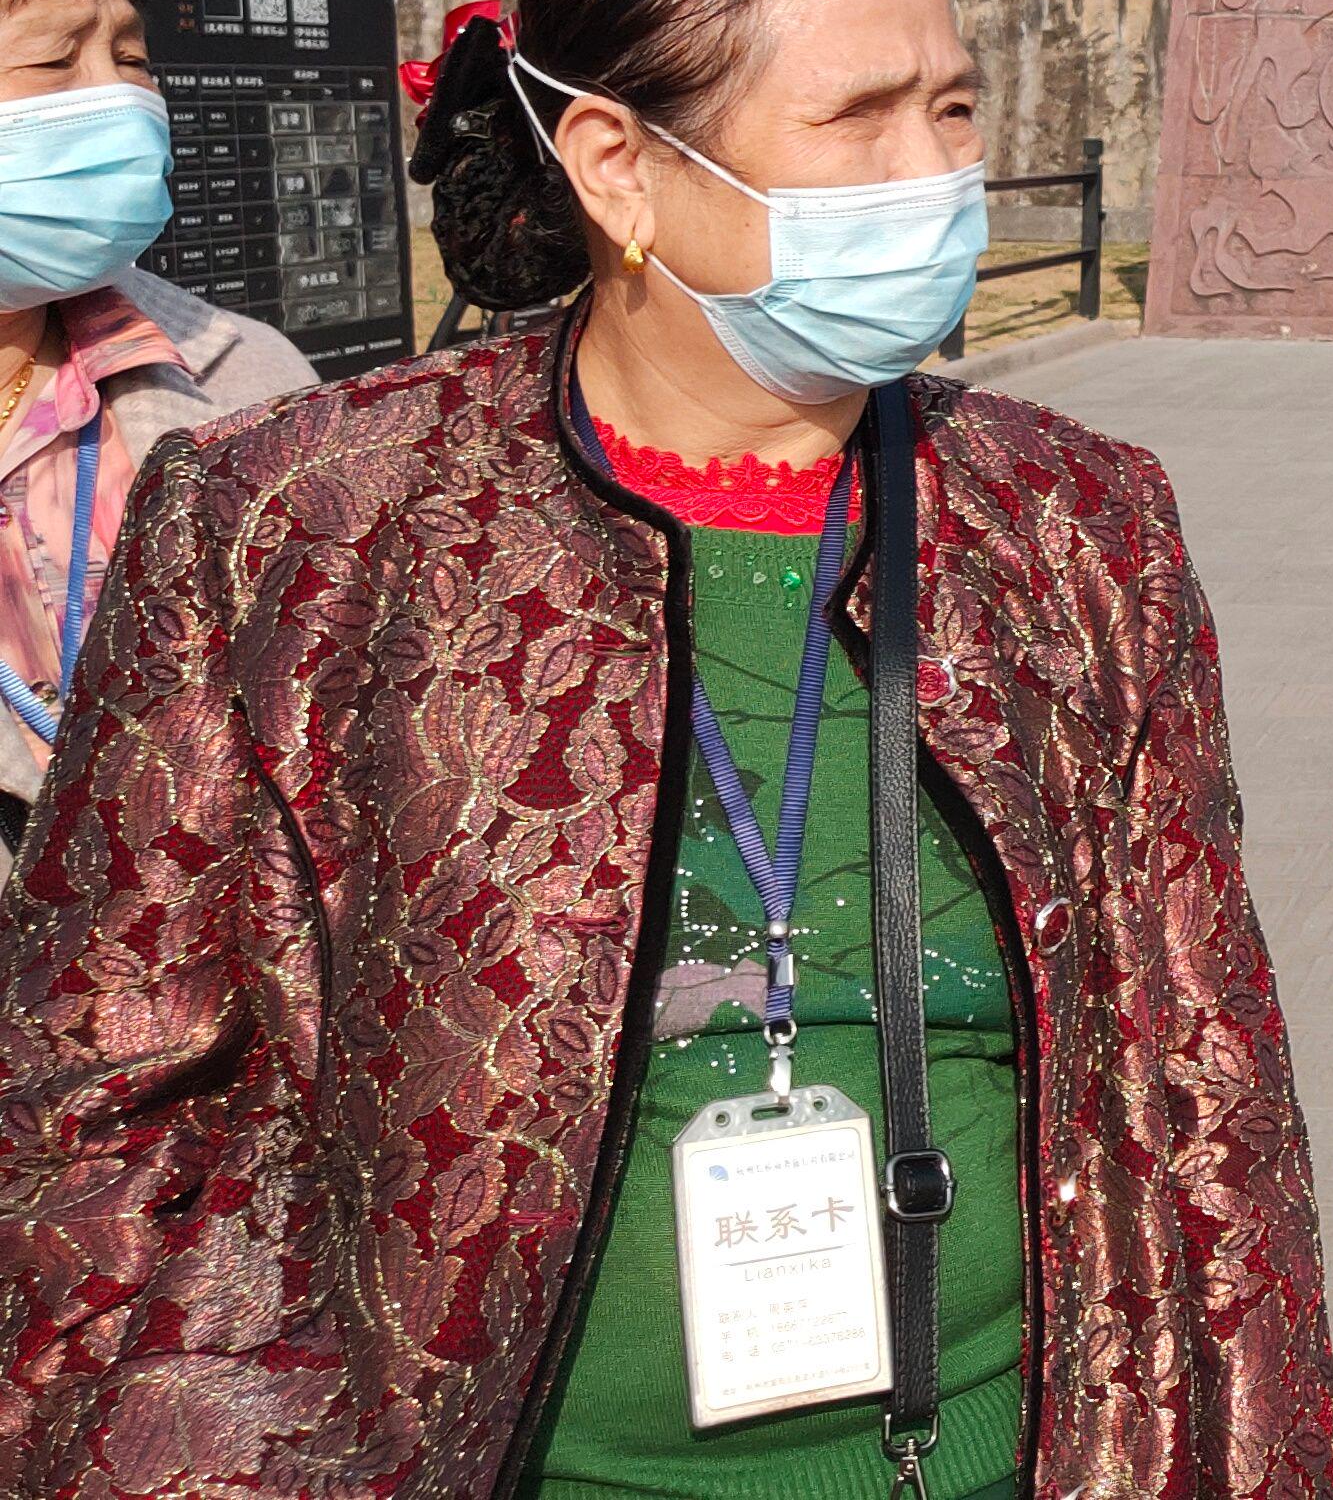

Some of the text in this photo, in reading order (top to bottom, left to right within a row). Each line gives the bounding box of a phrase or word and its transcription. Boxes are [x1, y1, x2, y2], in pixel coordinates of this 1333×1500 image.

[714, 1196, 855, 1249] 联系卡
[744, 1257, 832, 1282] Lianxika
